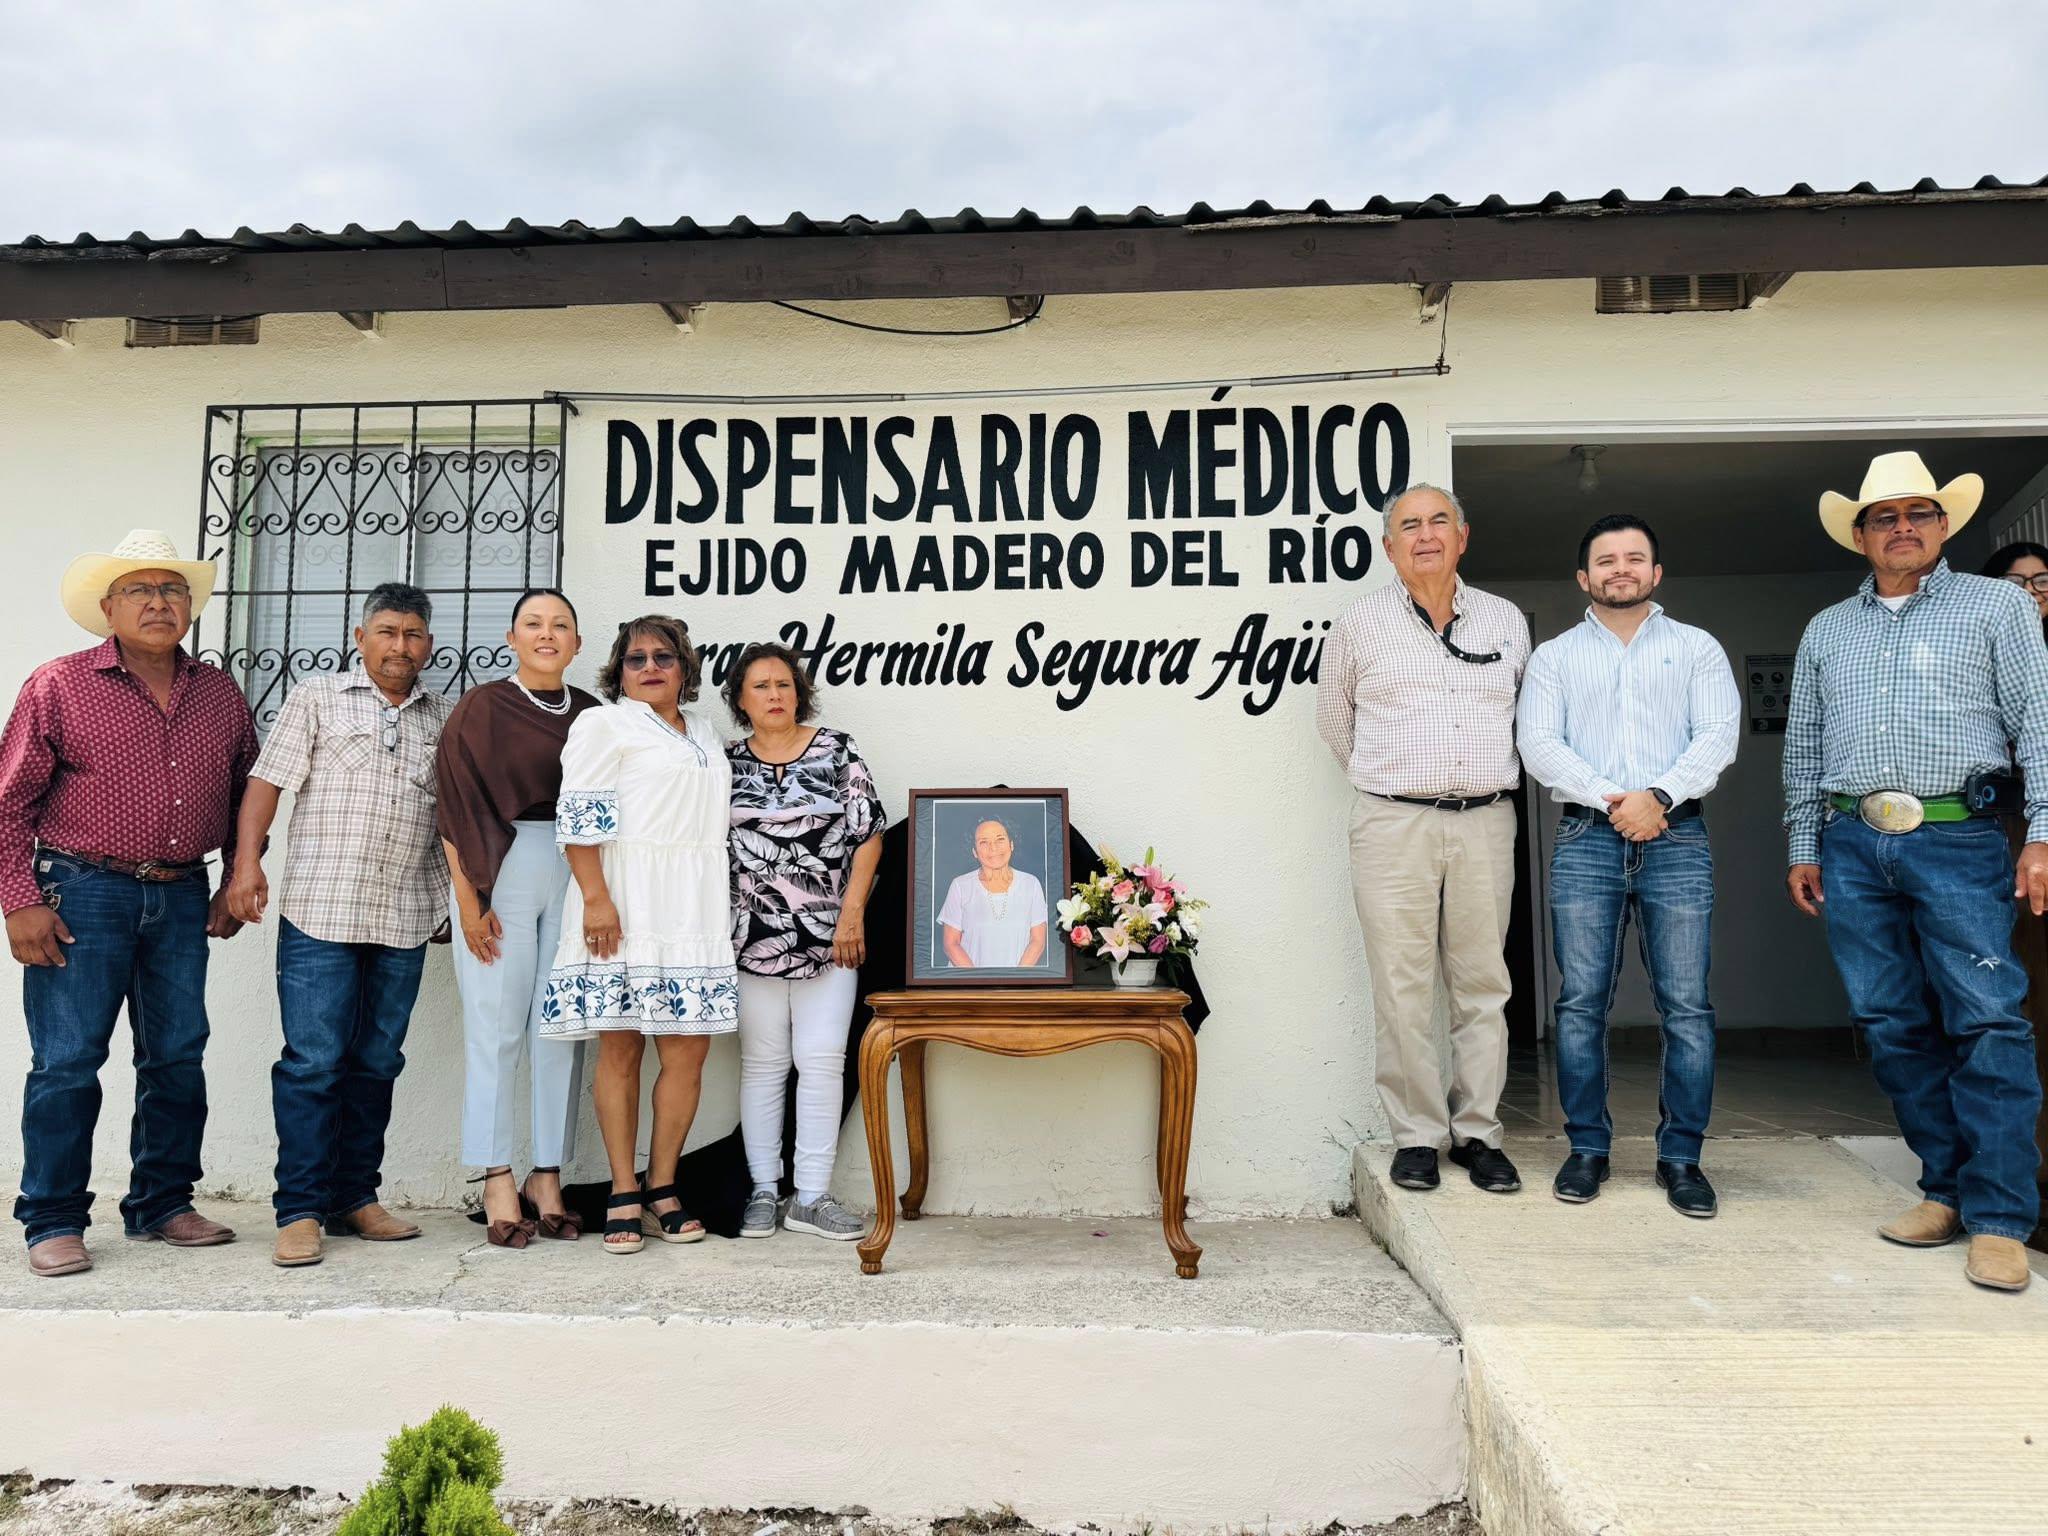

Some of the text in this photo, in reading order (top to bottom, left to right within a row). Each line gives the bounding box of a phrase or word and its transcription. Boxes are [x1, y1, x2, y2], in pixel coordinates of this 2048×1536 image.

[605, 385, 1411, 525] DISPENSARIO MÉDICO
[645, 513, 1372, 597] EJIDO MADERO DEL RÍO
[778, 613, 994, 687] Hermila
[1006, 621, 1201, 712] Segura
[1194, 612, 1332, 717] Agü
